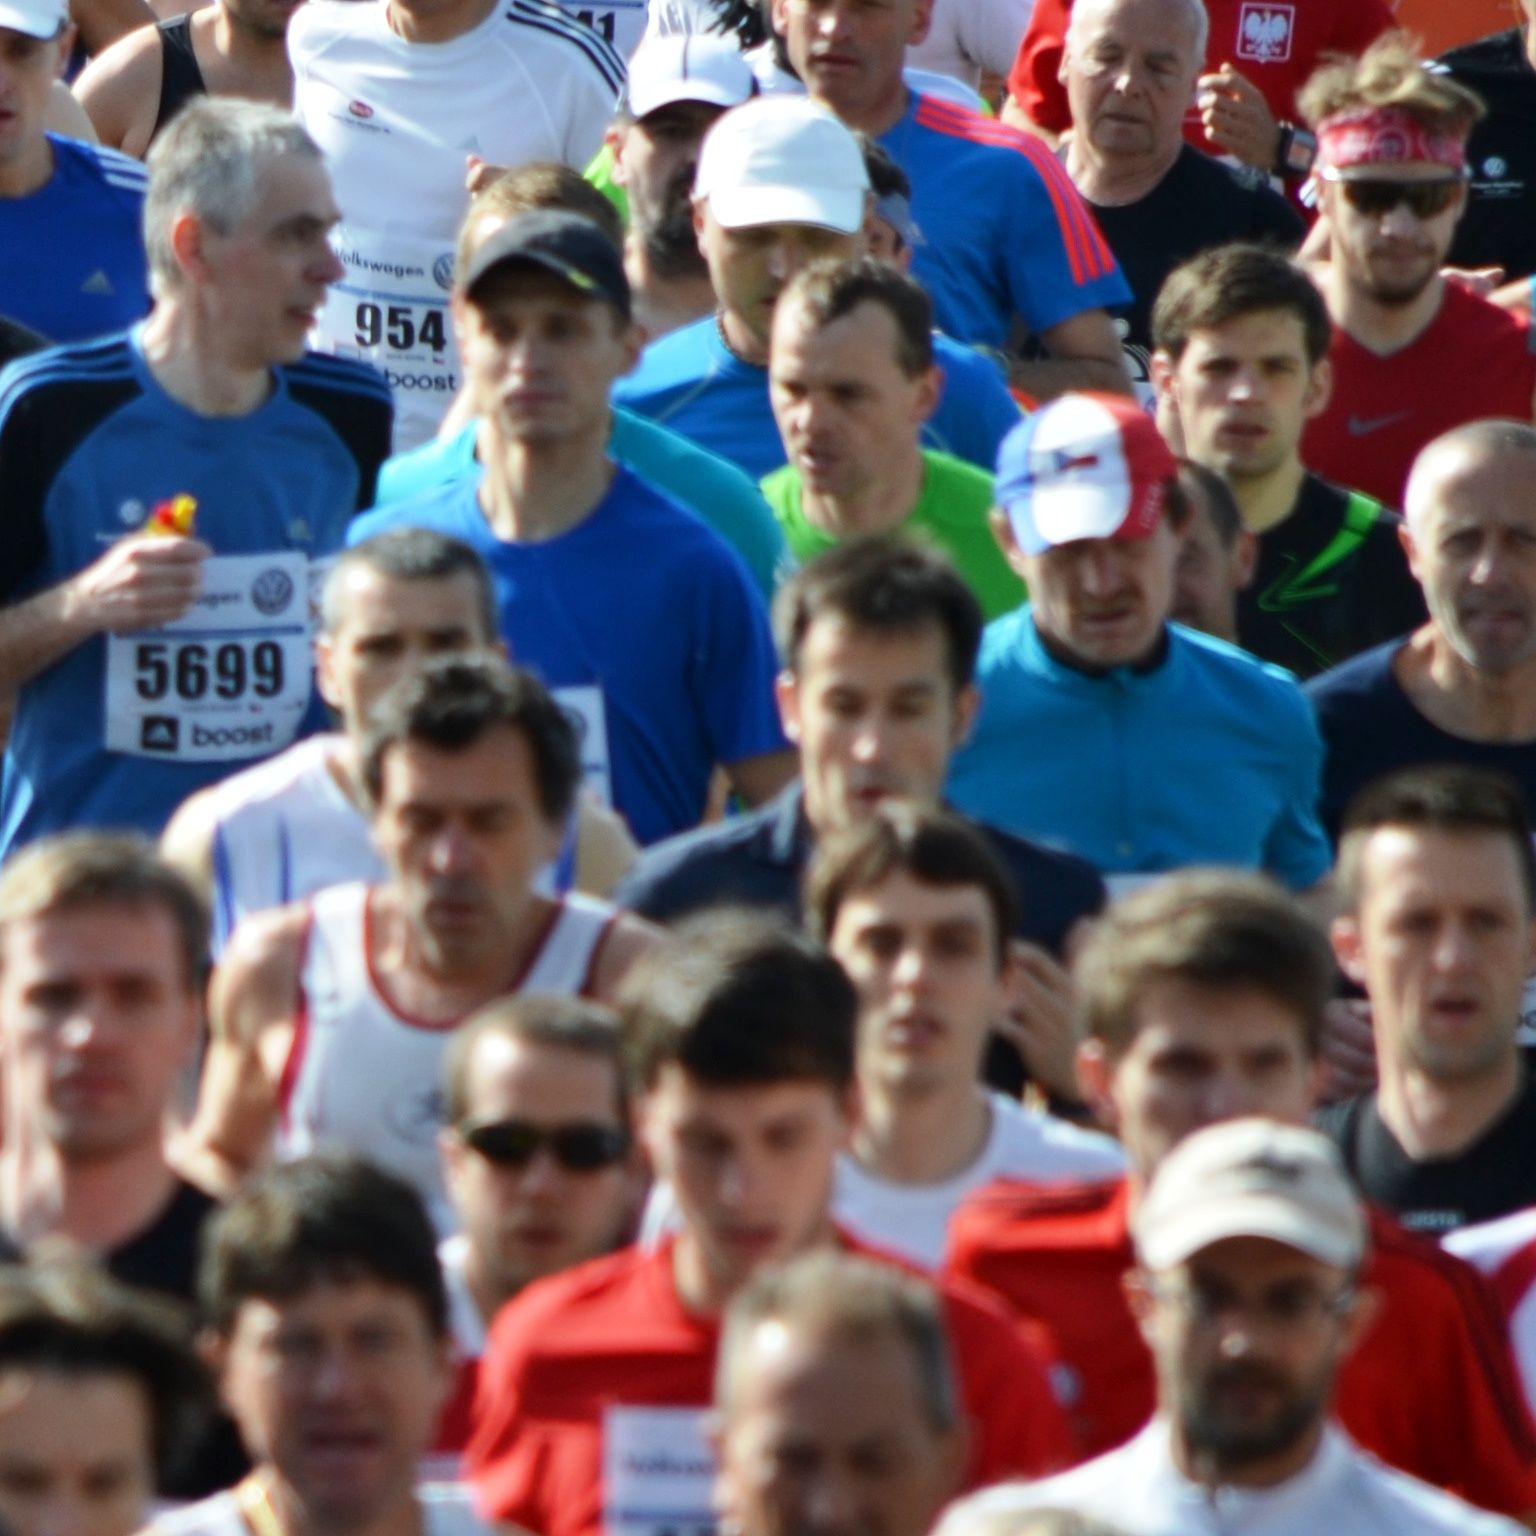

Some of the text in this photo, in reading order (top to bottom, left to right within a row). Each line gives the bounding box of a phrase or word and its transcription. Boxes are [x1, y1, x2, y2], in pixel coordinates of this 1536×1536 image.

[354, 302, 447, 351] 954
[134, 641, 285, 700] 5699
[190, 719, 274, 748] boost
